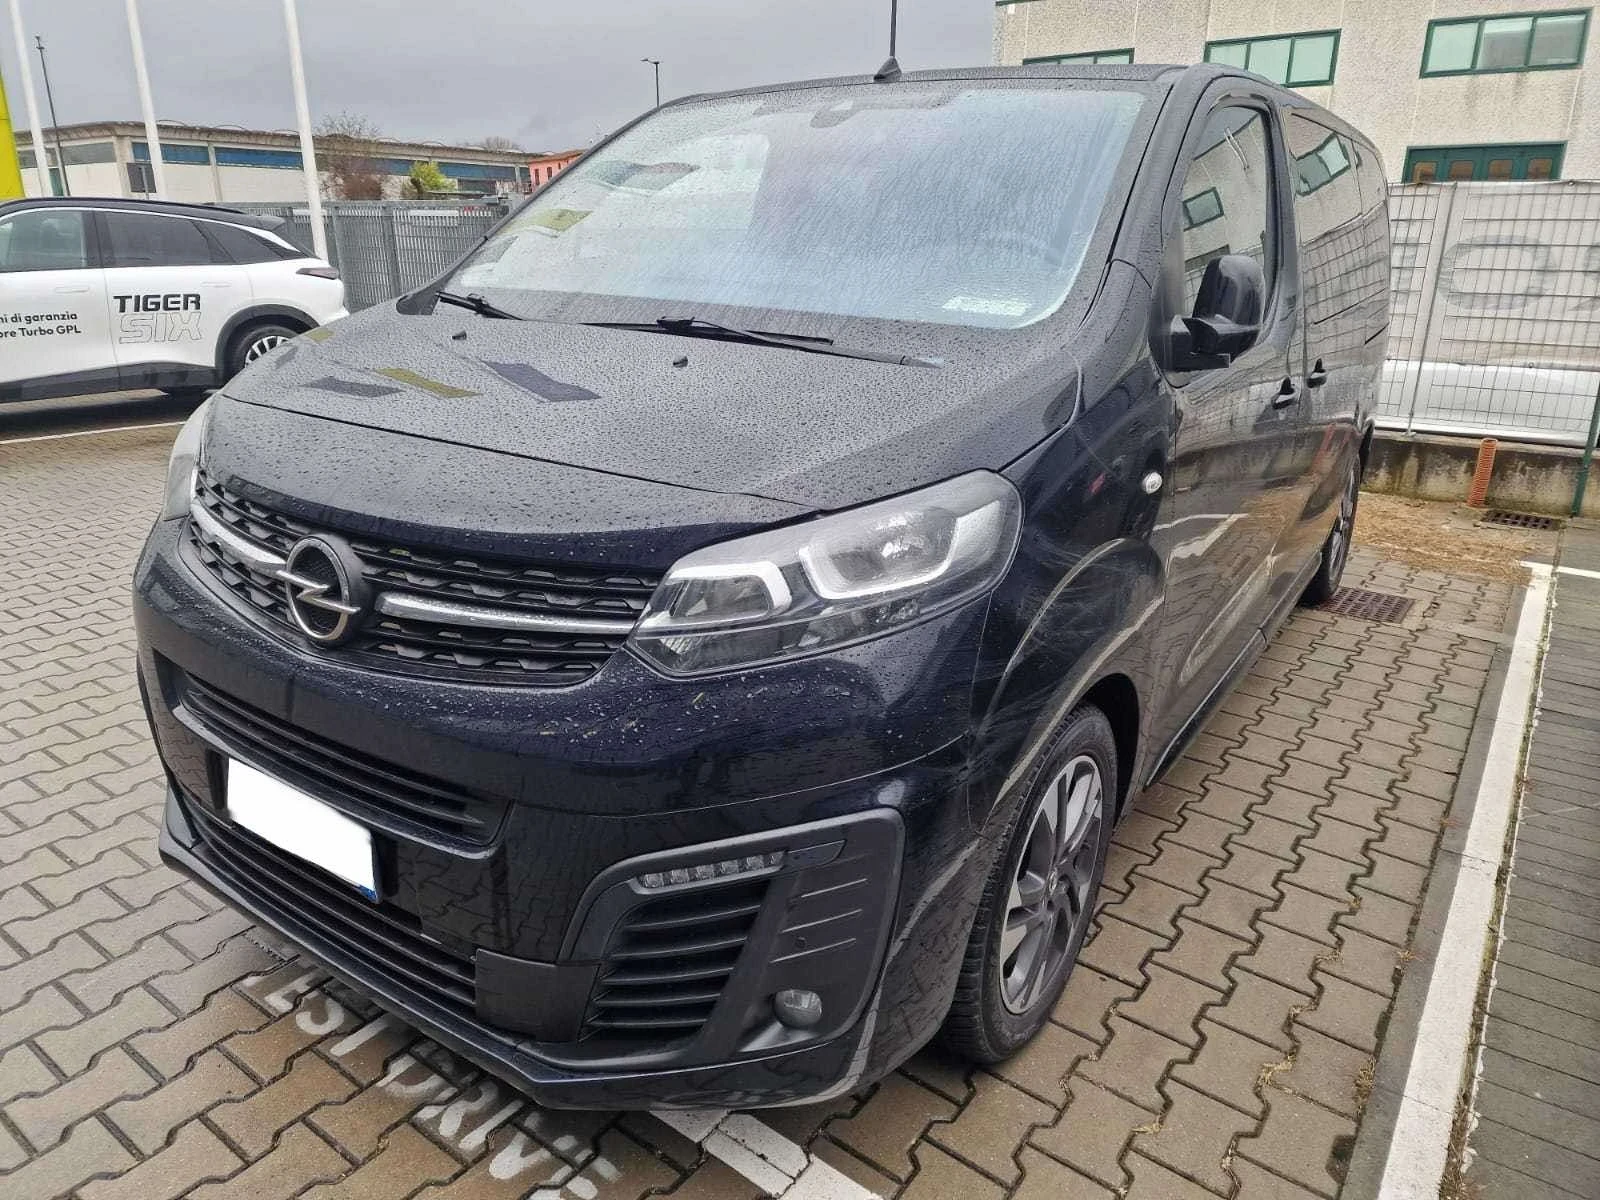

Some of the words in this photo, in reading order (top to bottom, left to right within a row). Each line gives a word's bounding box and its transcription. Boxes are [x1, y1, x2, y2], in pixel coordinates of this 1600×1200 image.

[113, 293, 201, 313] TIGER
[10, 313, 22, 323] di
[24, 311, 78, 325] garanzia
[18, 326, 54, 337] Turbo
[56, 324, 82, 335] GPL
[119, 311, 202, 344] SIX
